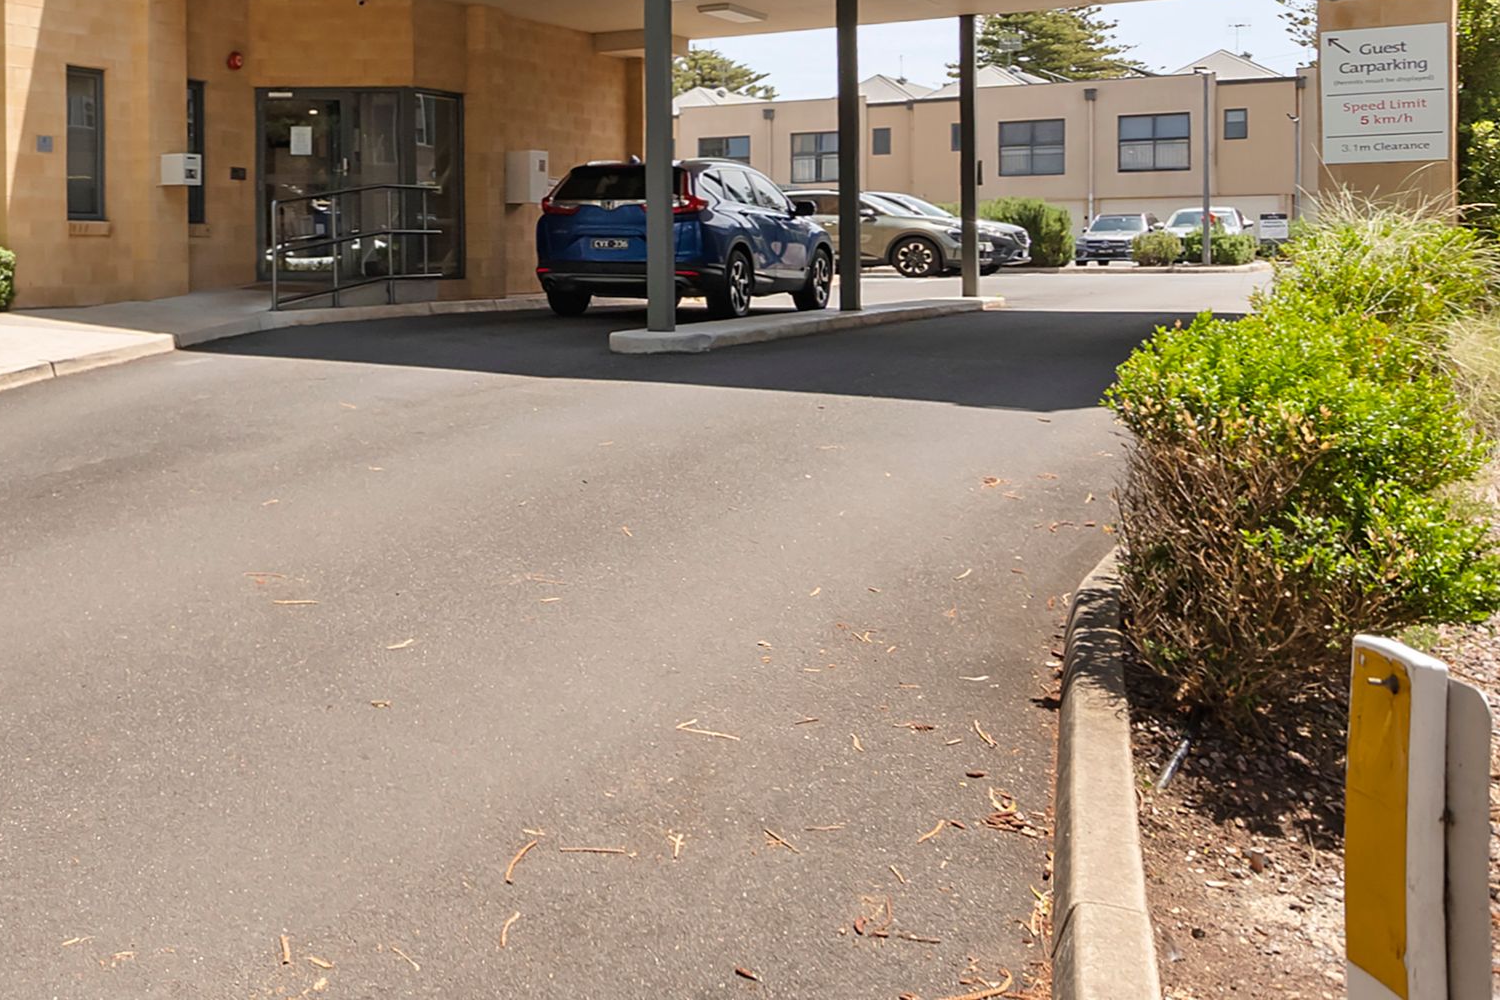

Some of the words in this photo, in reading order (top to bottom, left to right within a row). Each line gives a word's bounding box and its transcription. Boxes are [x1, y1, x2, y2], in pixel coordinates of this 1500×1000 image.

[1359, 41, 1407, 55] Guest
[1339, 59, 1428, 75] Carparking
[1343, 100, 1385, 114] Speed
[1390, 98, 1428, 110] Limit
[1360, 115, 1369, 125] 5
[1373, 113, 1413, 125] km/h
[1373, 142, 1430, 151] Clearance
